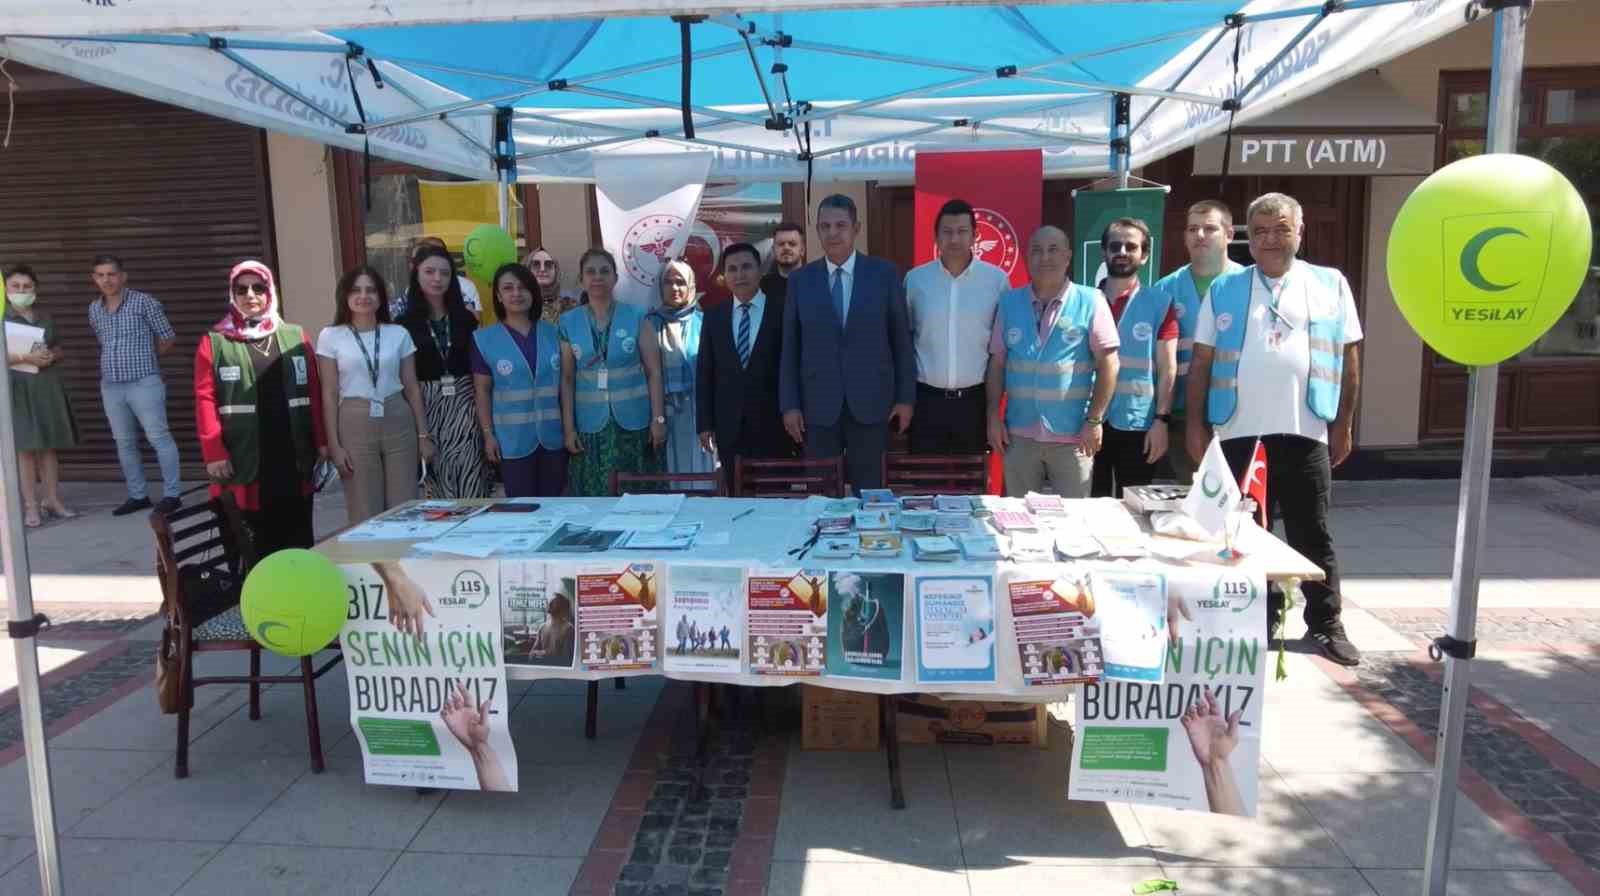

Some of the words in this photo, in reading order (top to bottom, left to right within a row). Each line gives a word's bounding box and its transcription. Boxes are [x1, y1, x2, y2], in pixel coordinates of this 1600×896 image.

[1241, 139, 1297, 163] PTT
[1306, 138, 1386, 169] (ATM)
[460, 581, 481, 592] 115
[1223, 582, 1247, 594] 115
[439, 624, 496, 673] İÇİN
[1194, 628, 1259, 680] İÇİN
